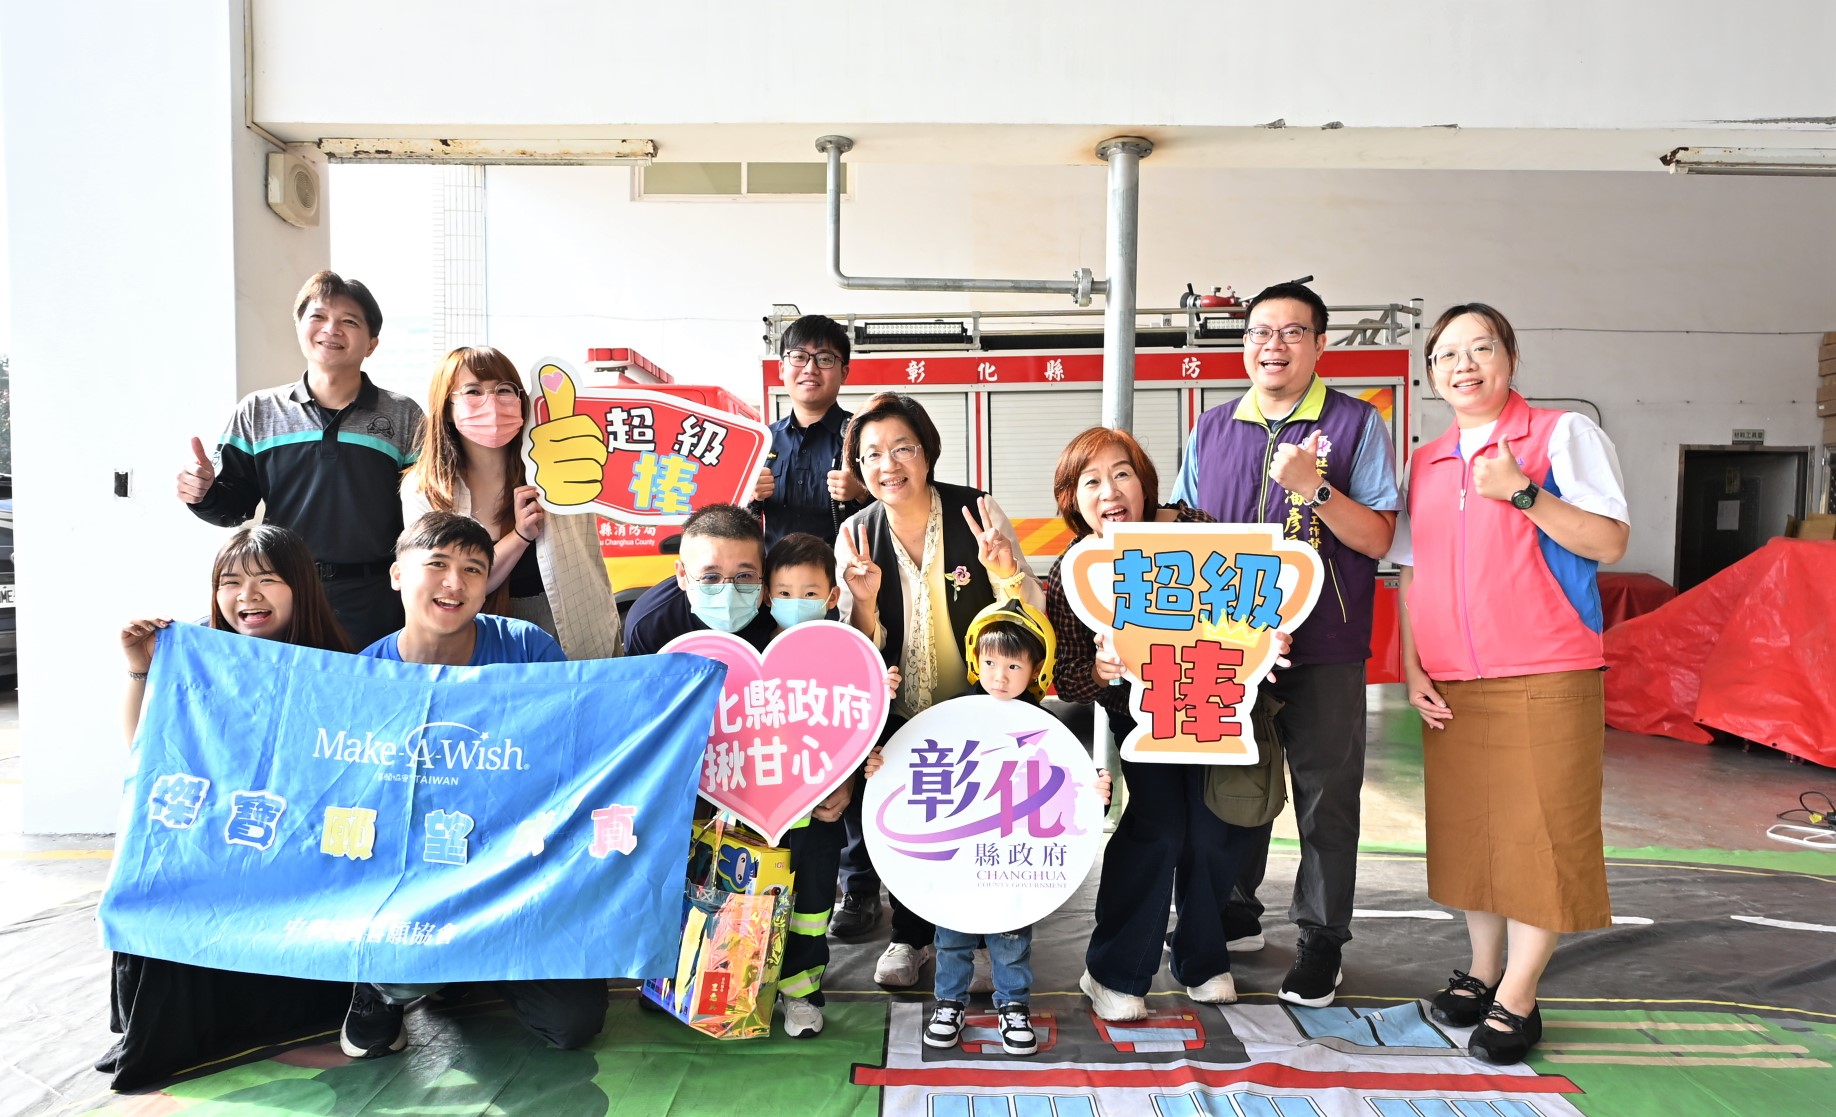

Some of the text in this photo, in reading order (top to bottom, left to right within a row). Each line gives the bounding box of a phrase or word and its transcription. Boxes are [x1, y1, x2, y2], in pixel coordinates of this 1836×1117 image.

[605, 406, 728, 467] 超級
[629, 450, 700, 515] 棒
[1308, 515, 1322, 551] 工作督
[1112, 549, 1283, 631] 超級
[1140, 639, 1245, 742] 棒
[414, 774, 459, 786] TAIWAN
[705, 734, 833, 793] 揪甘心
[907, 738, 1066, 839] 彰化
[974, 842, 1068, 867] 縣政府
[976, 870, 1067, 881] CHANGHUA
